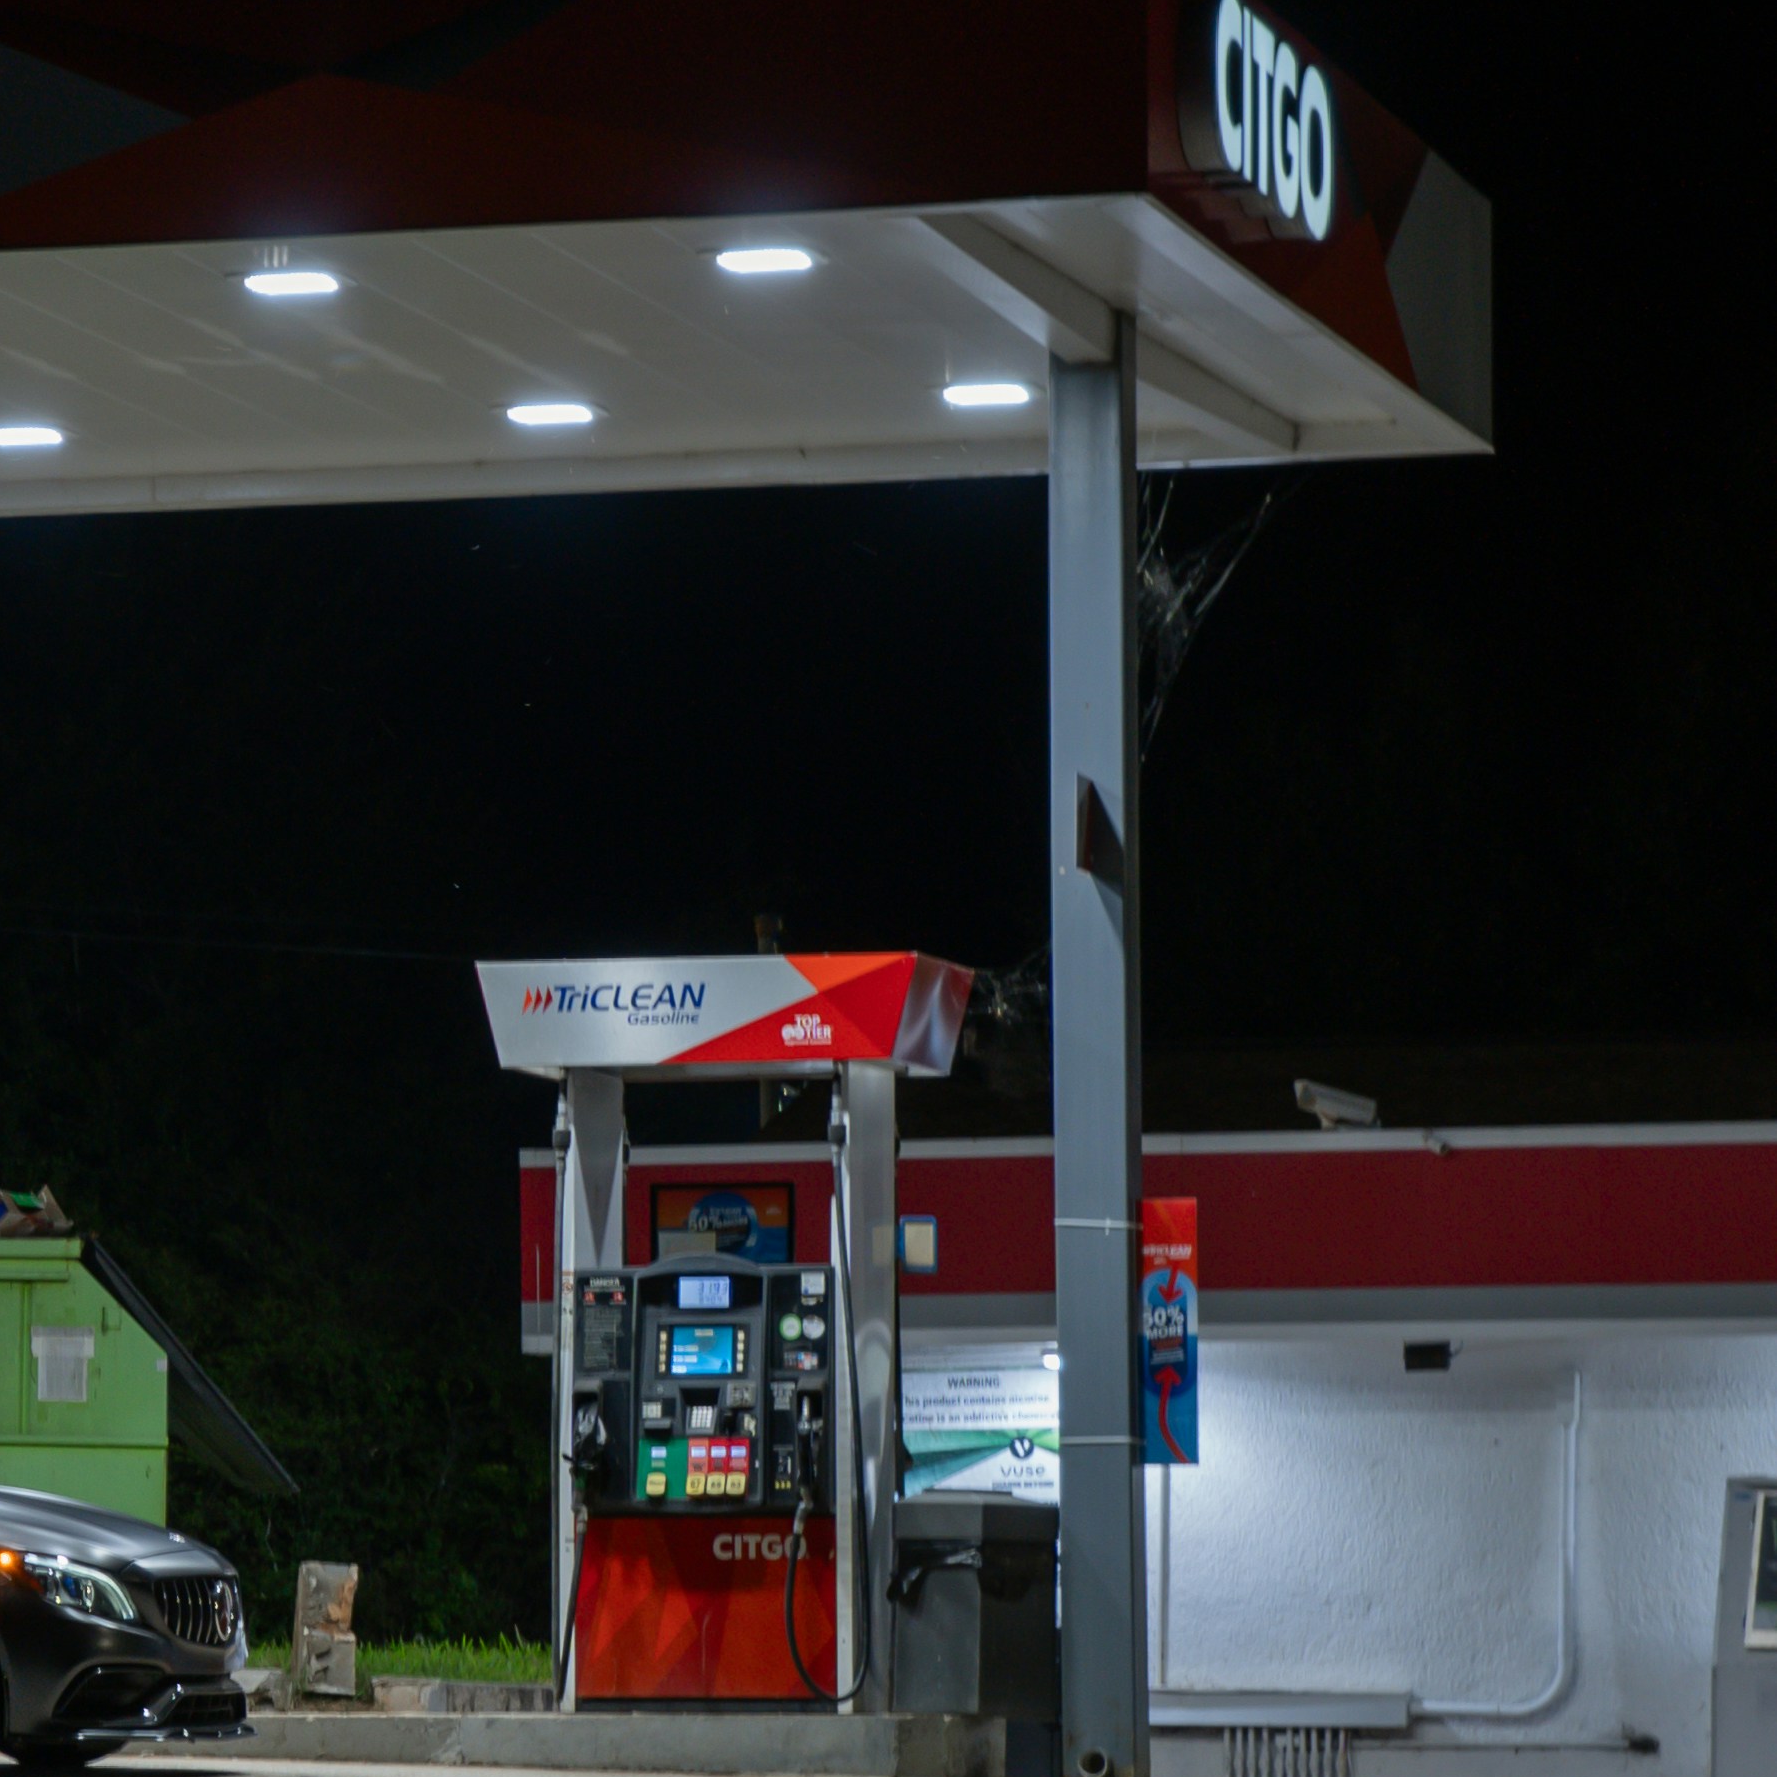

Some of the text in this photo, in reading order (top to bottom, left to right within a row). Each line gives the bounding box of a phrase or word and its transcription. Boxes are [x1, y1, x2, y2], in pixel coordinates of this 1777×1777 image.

[553, 981, 706, 1013] TriCLEAN
[627, 1012, 700, 1026] Gasoline
[793, 1013, 821, 1027] TOP
[947, 1376, 1000, 1389] WARNING
[904, 1393, 921, 1408] his
[923, 1393, 962, 1410] product
[963, 1392, 1007, 1407] contains
[712, 1532, 807, 1561] CITGO
